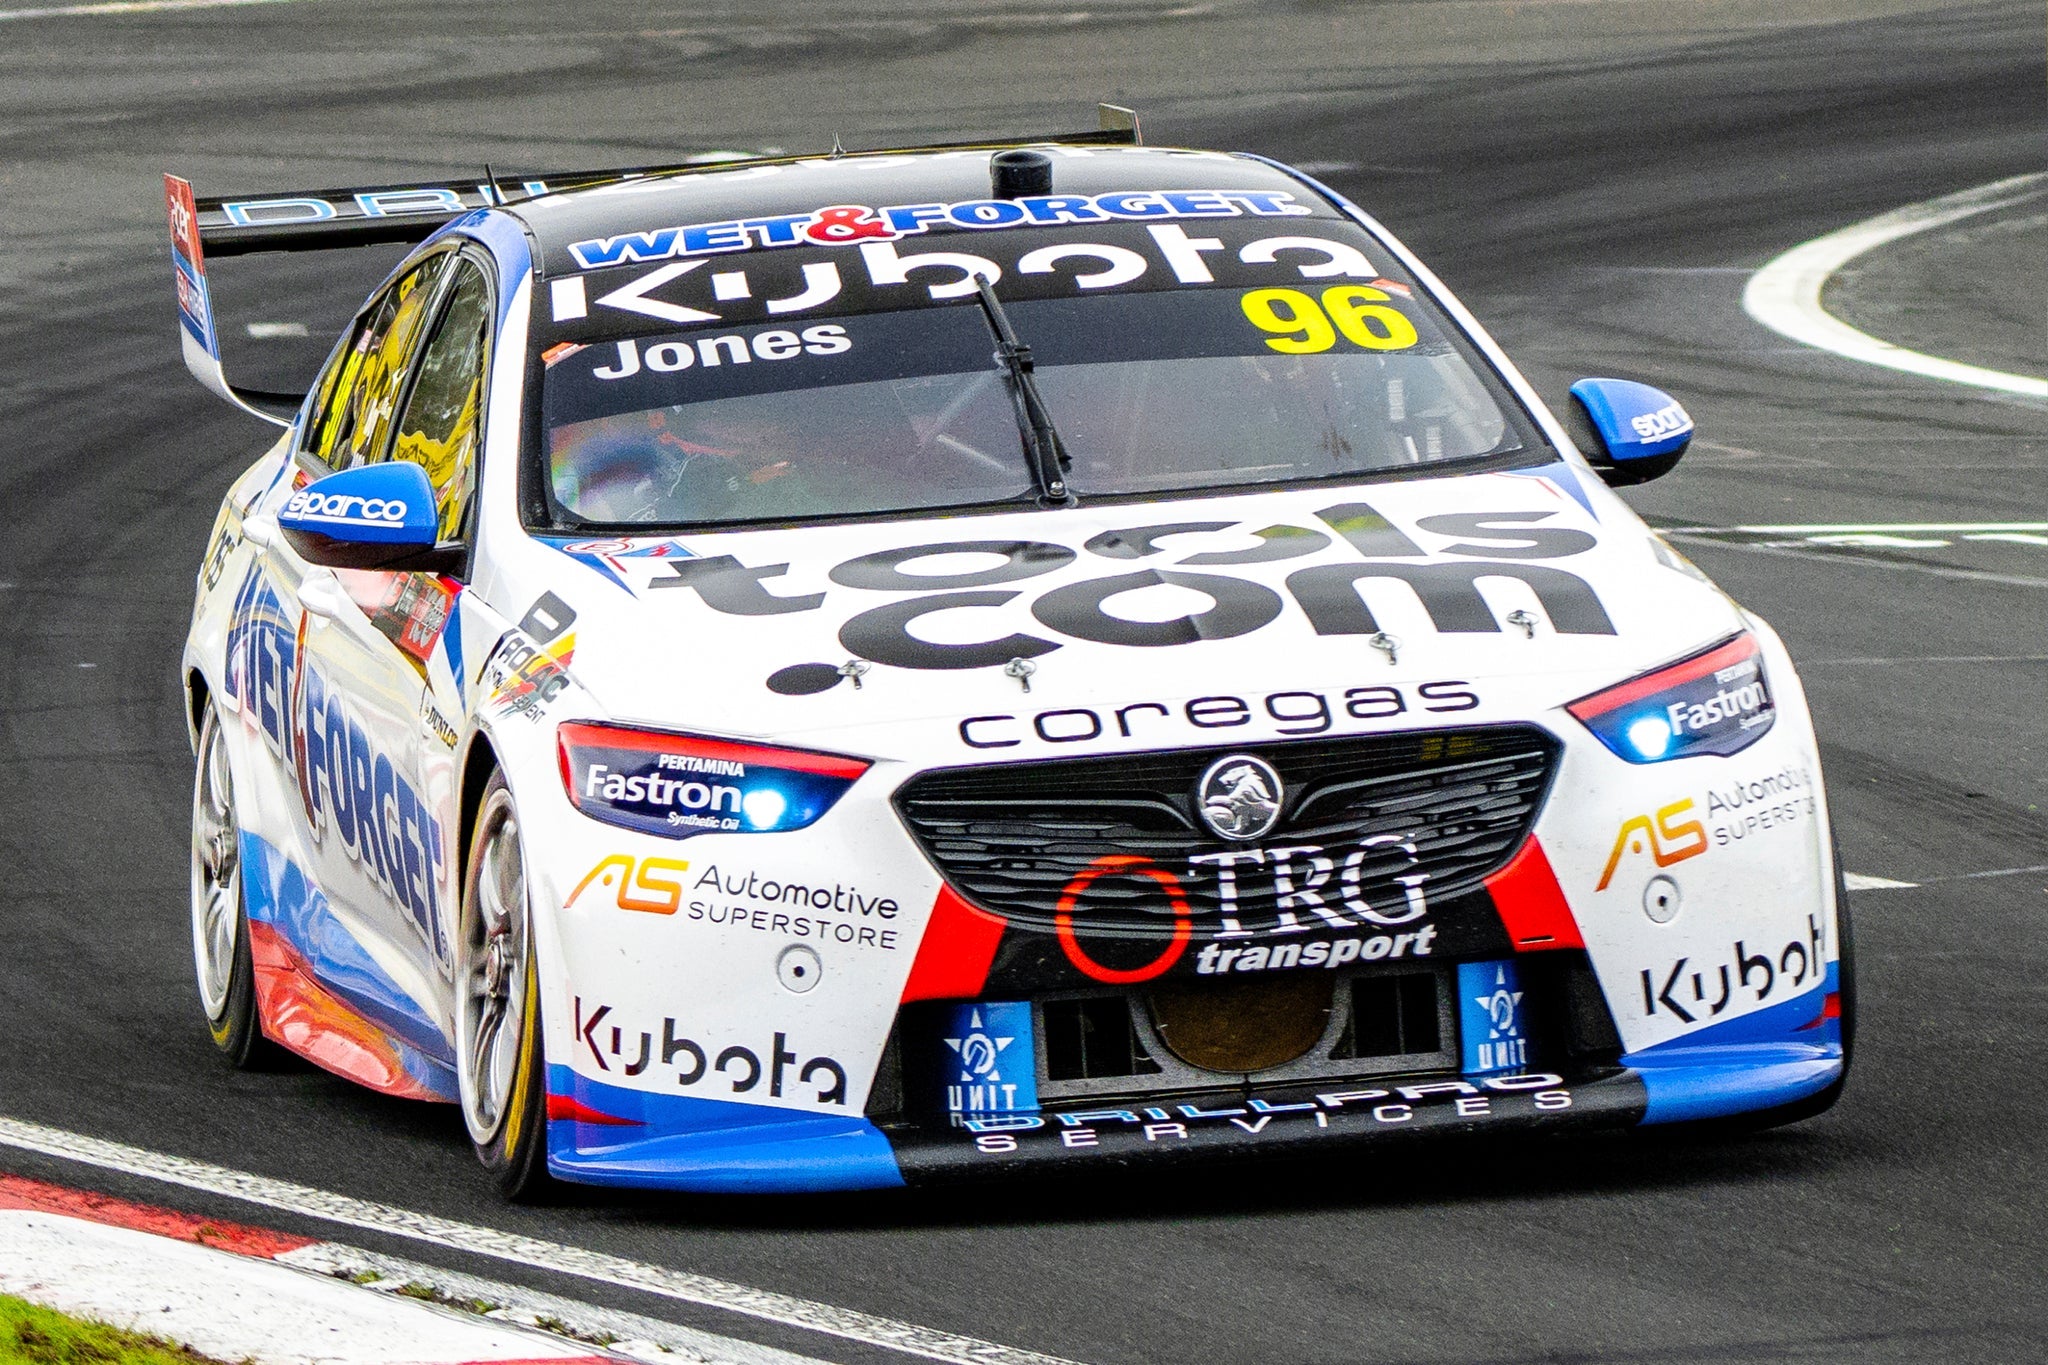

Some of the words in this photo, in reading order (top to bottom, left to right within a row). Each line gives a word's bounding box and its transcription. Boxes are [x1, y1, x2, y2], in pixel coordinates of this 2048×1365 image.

[551, 224, 1379, 323] Kubota
[1240, 285, 1419, 354] 96
[593, 325, 853, 380] Jones
[287, 490, 408, 521] sparco
[647, 502, 1598, 616] tools
[766, 561, 1618, 696] .com
[957, 680, 1480, 750] coregas
[1667, 681, 1768, 736] Fastron
[585, 764, 743, 813] Fastron
[658, 753, 745, 777] PERTAMINA
[666, 811, 720, 830] Synthetic
[720, 816, 740, 831] Oil
[1594, 797, 1709, 893] AS
[562, 853, 690, 916] AS
[692, 864, 899, 919] Automotive
[1187, 832, 1431, 939] TRG
[687, 901, 900, 950] SUPERSTORE
[1196, 924, 1438, 976] transport
[574, 995, 848, 1106] Kubota
[1478, 1038, 1527, 1070] UNIT
[947, 1083, 1018, 1111] UNIT
[963, 1074, 1565, 1132] DRILLPRO
[974, 1090, 1573, 1153] SERVICES
